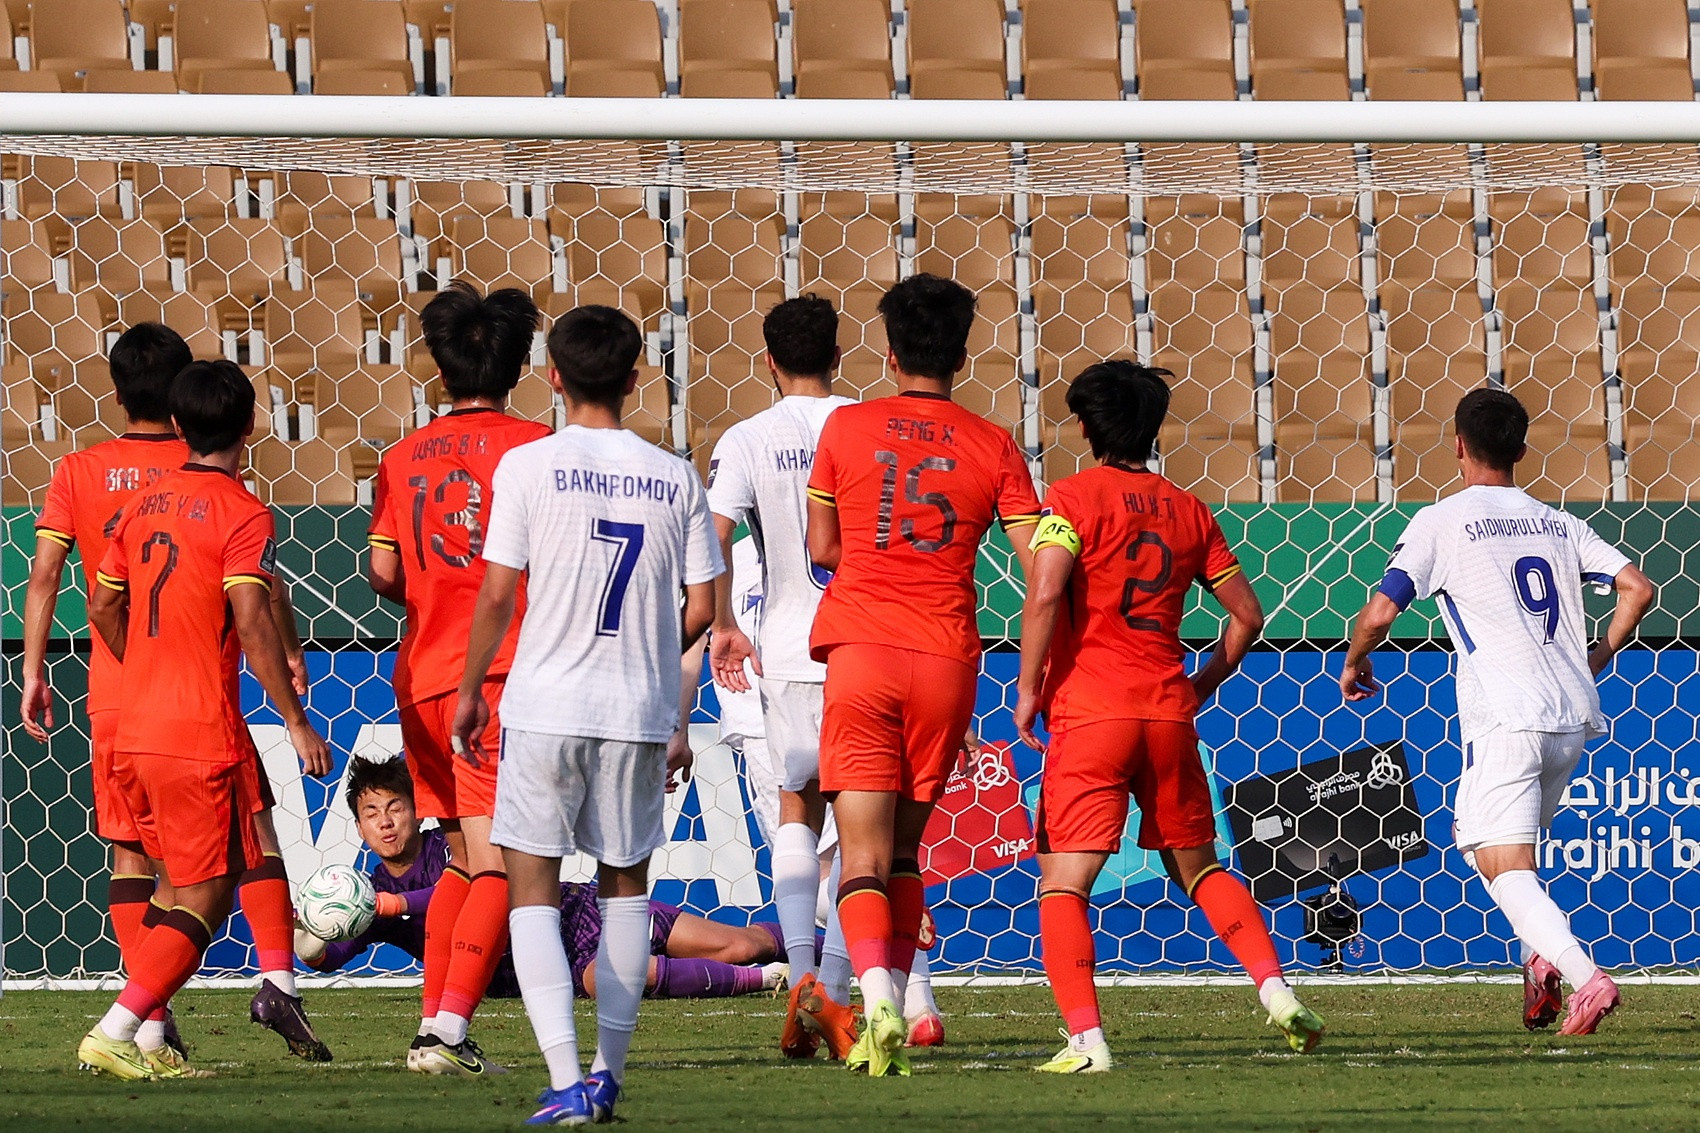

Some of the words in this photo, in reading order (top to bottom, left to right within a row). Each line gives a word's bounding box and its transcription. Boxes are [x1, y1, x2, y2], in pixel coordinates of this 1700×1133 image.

[886, 418, 936, 442] PENG
[412, 434, 454, 461] WANG
[775, 448, 817, 472] KHAY
[875, 450, 957, 553] 15
[1122, 493, 1145, 513] HU
[409, 468, 482, 571] 13
[1464, 517, 1569, 542] SAIDNURULLAYEV
[141, 531, 180, 638] 7
[591, 518, 644, 637] 7
[1119, 530, 1173, 632] 2
[1511, 555, 1560, 645] 9
[944, 781, 968, 795] bank
[990, 838, 1029, 858] VISA
[1386, 830, 1420, 850] VISA
